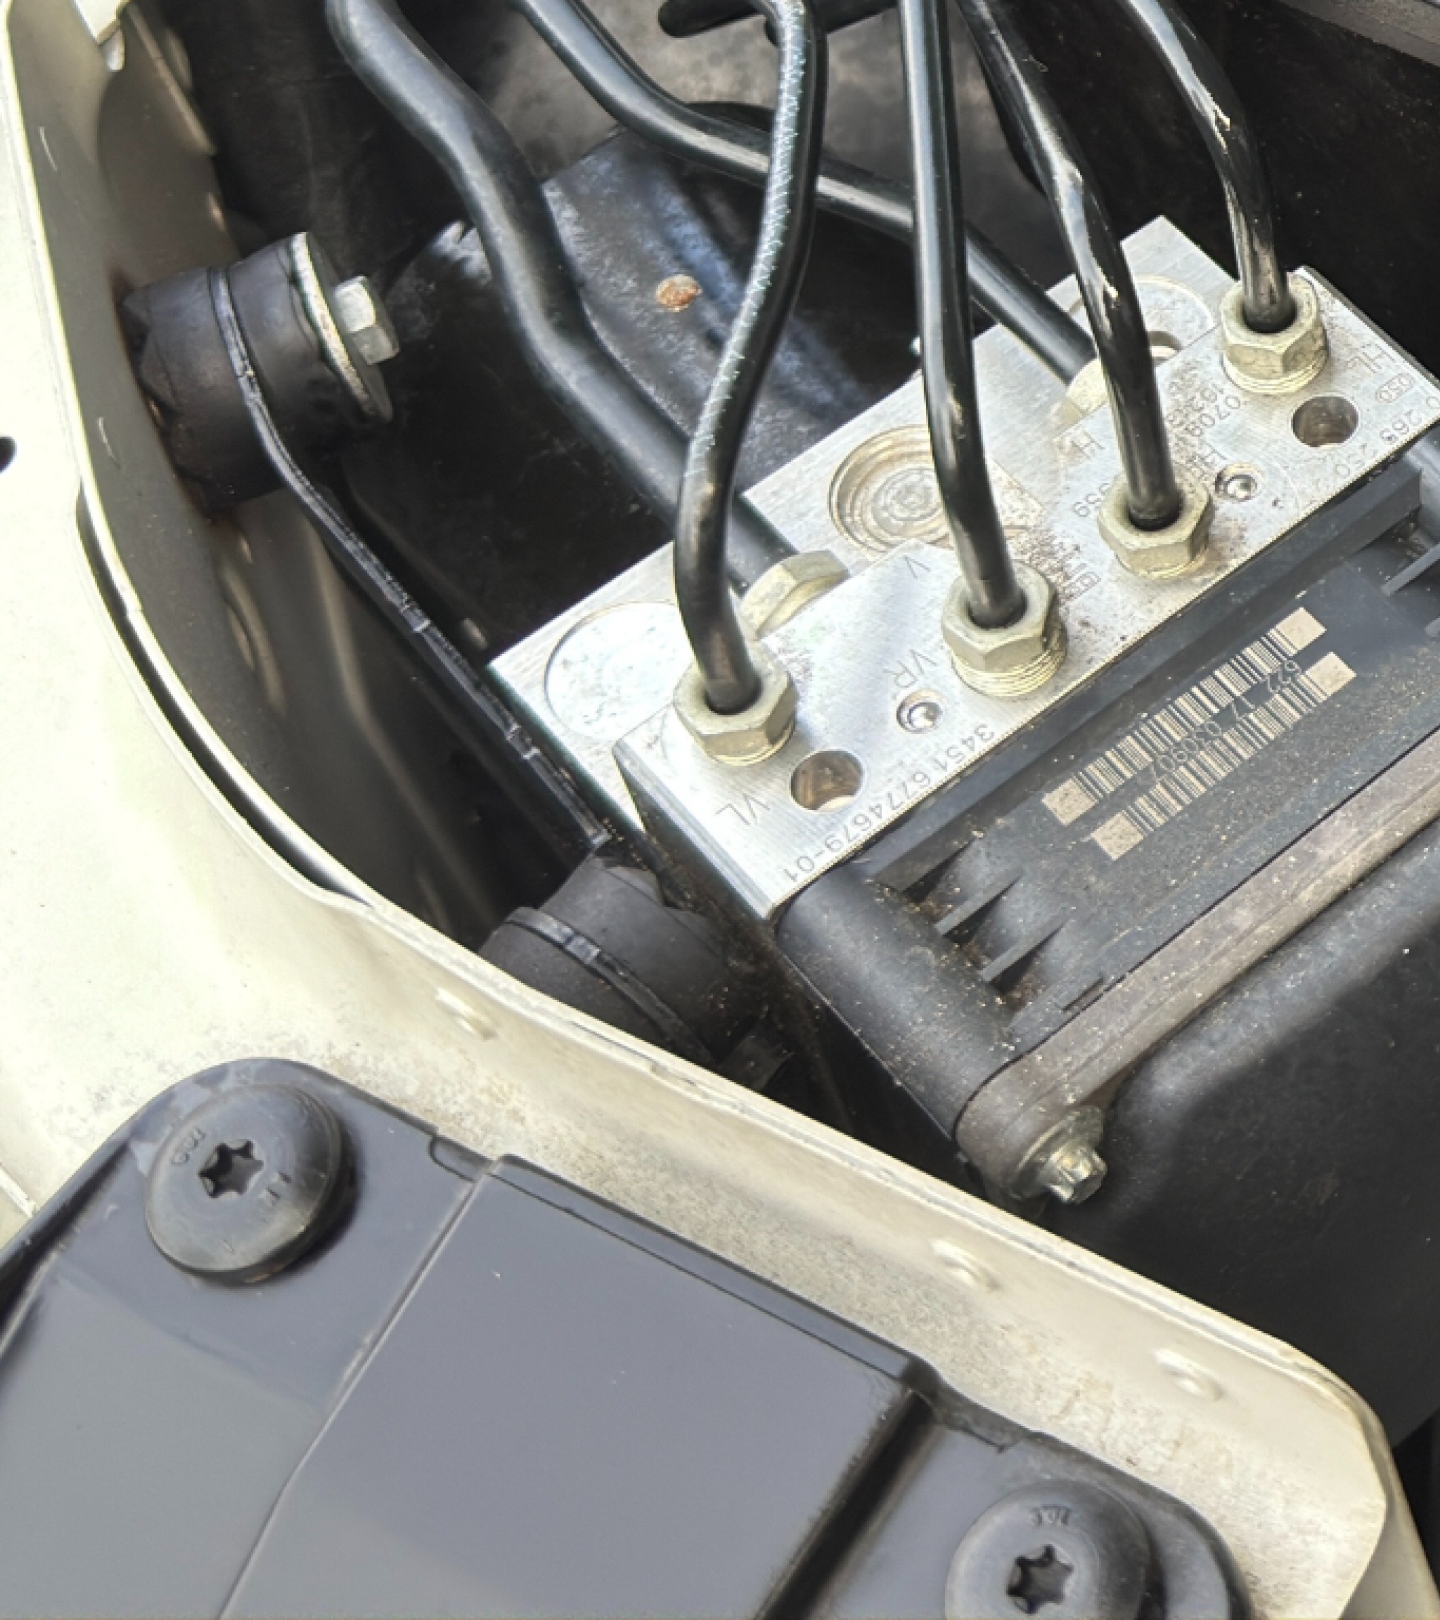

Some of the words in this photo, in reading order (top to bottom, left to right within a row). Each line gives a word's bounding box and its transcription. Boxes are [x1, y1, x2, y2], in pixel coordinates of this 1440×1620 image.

[1347, 341, 1397, 376] HL
[883, 647, 939, 690] VR
[931, 722, 997, 774] 3451
[713, 790, 772, 827] VL
